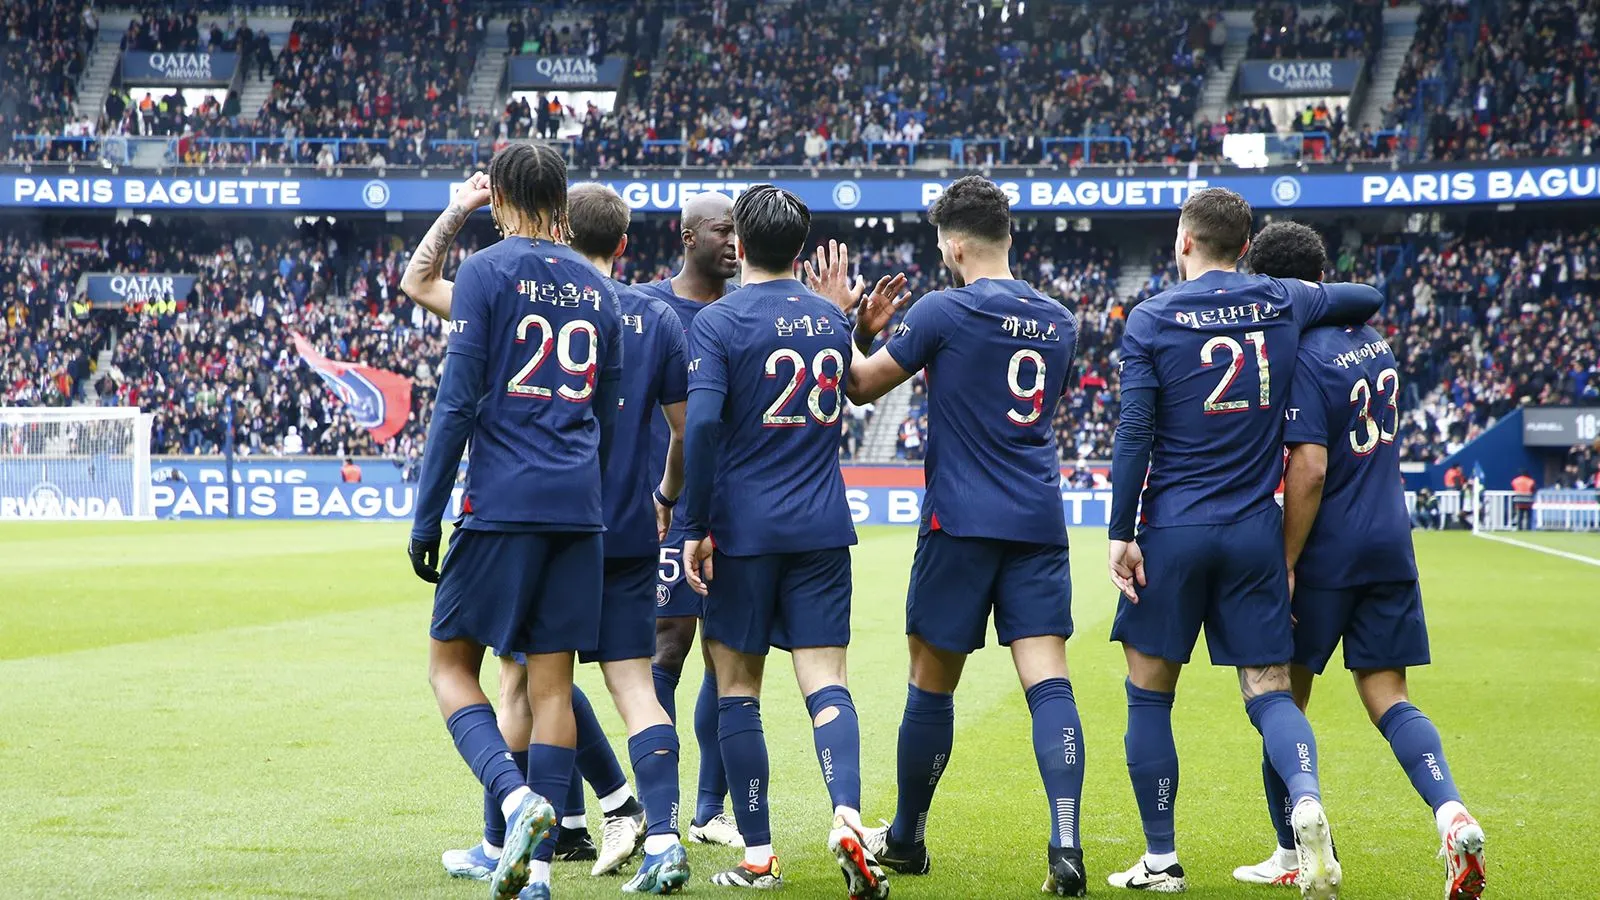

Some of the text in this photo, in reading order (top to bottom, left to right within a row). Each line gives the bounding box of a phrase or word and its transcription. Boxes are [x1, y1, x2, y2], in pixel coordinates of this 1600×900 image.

[149, 53, 211, 72] QATAR
[165, 67, 212, 79] AIRWAYS
[536, 58, 597, 76] QATAR
[1268, 62, 1332, 82] QATAR
[14, 178, 301, 205] PARIS BAGUETTE
[1362, 166, 1600, 203] PARIS BAGU
[110, 275, 174, 297] QATAR
[1175, 301, 1280, 329] 에르난데스
[506, 313, 599, 403] 29
[1199, 330, 1271, 416] 21
[762, 348, 844, 427] 28
[1006, 348, 1047, 427] 9
[1349, 367, 1399, 457] 33
[0, 496, 125, 517] RWANDA
[151, 485, 276, 516] PARIS
[1062, 727, 1077, 765] PARIS
[1296, 742, 1313, 772] PARIS
[821, 747, 835, 784] PARIS
[928, 752, 946, 786] PARIS
[1422, 752, 1444, 781] PARIS
[749, 778, 760, 812] PARIS
[1157, 777, 1171, 811] PARIS
